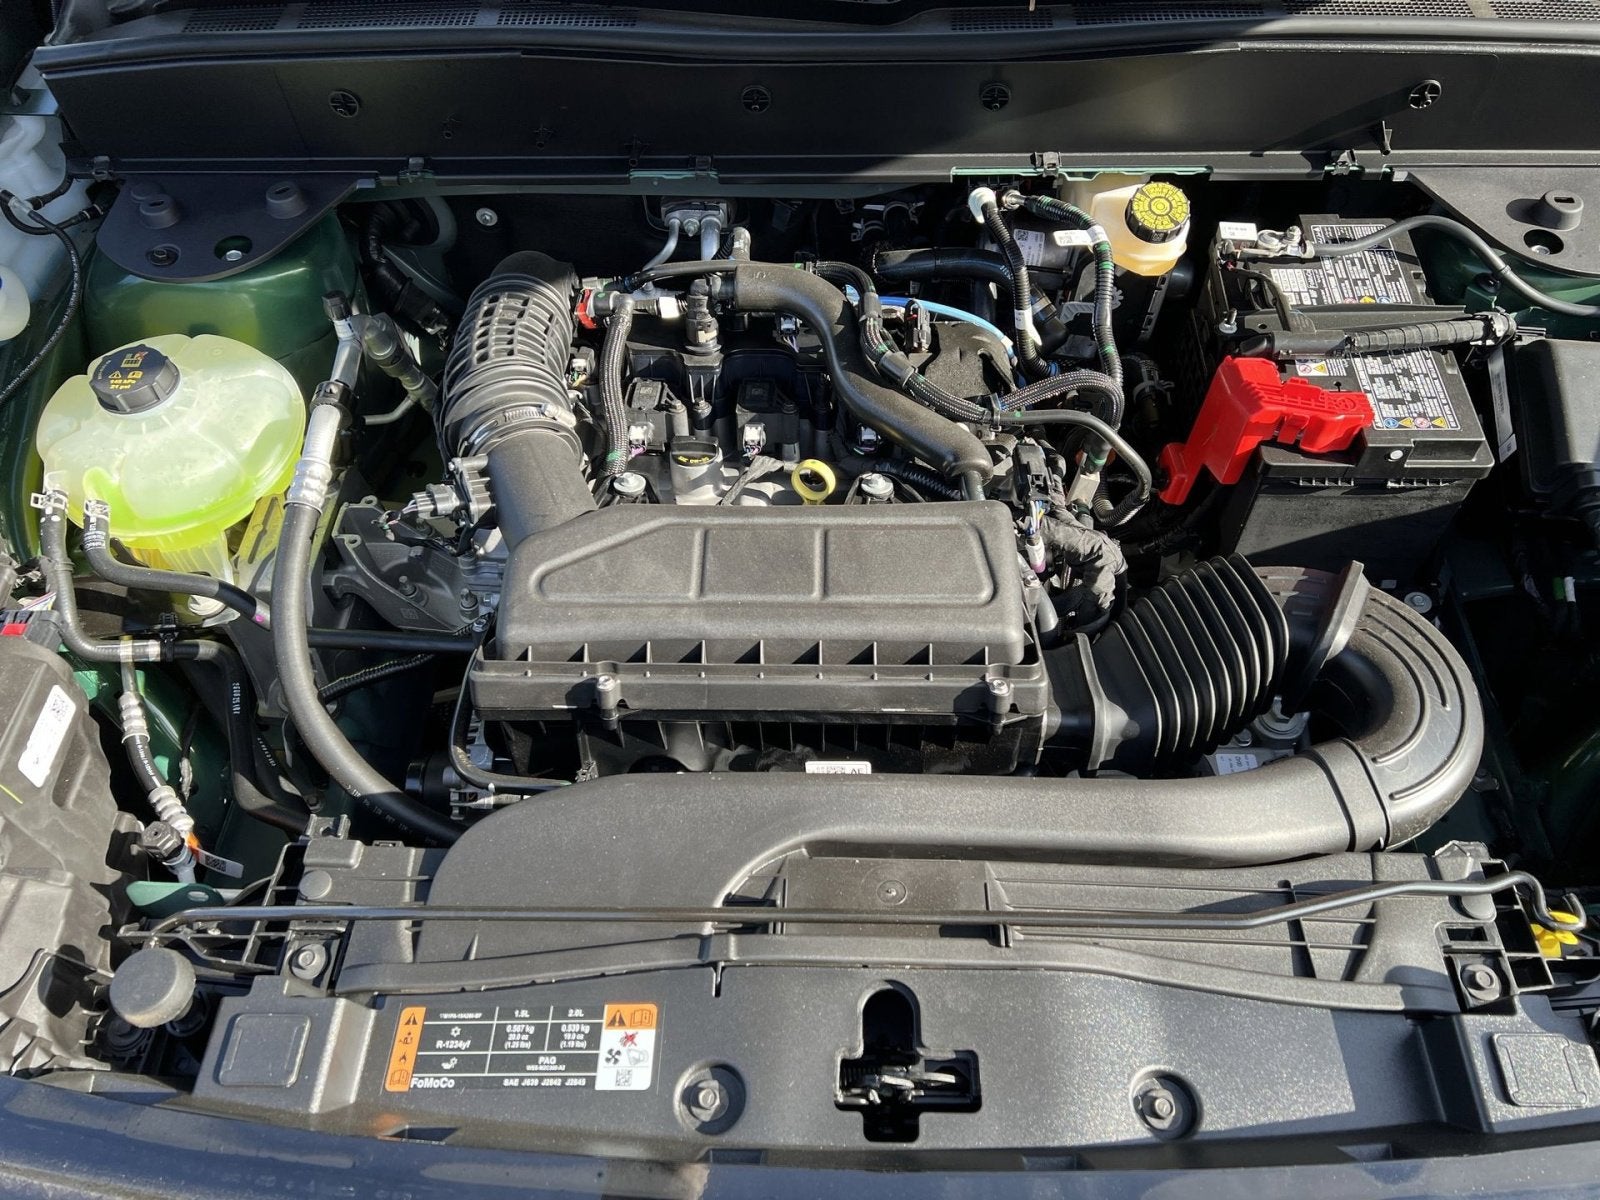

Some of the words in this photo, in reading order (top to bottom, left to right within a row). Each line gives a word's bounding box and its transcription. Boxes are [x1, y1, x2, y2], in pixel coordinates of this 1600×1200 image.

[514, 1009, 530, 1018] 1.5L
[568, 1008, 584, 1018] 2.0L
[525, 1024, 536, 1035] kg
[580, 1023, 591, 1034] kg
[435, 1039, 471, 1051] R-1234yf
[410, 1077, 455, 1088] FoMoCo
[502, 1078, 520, 1087] SAE
